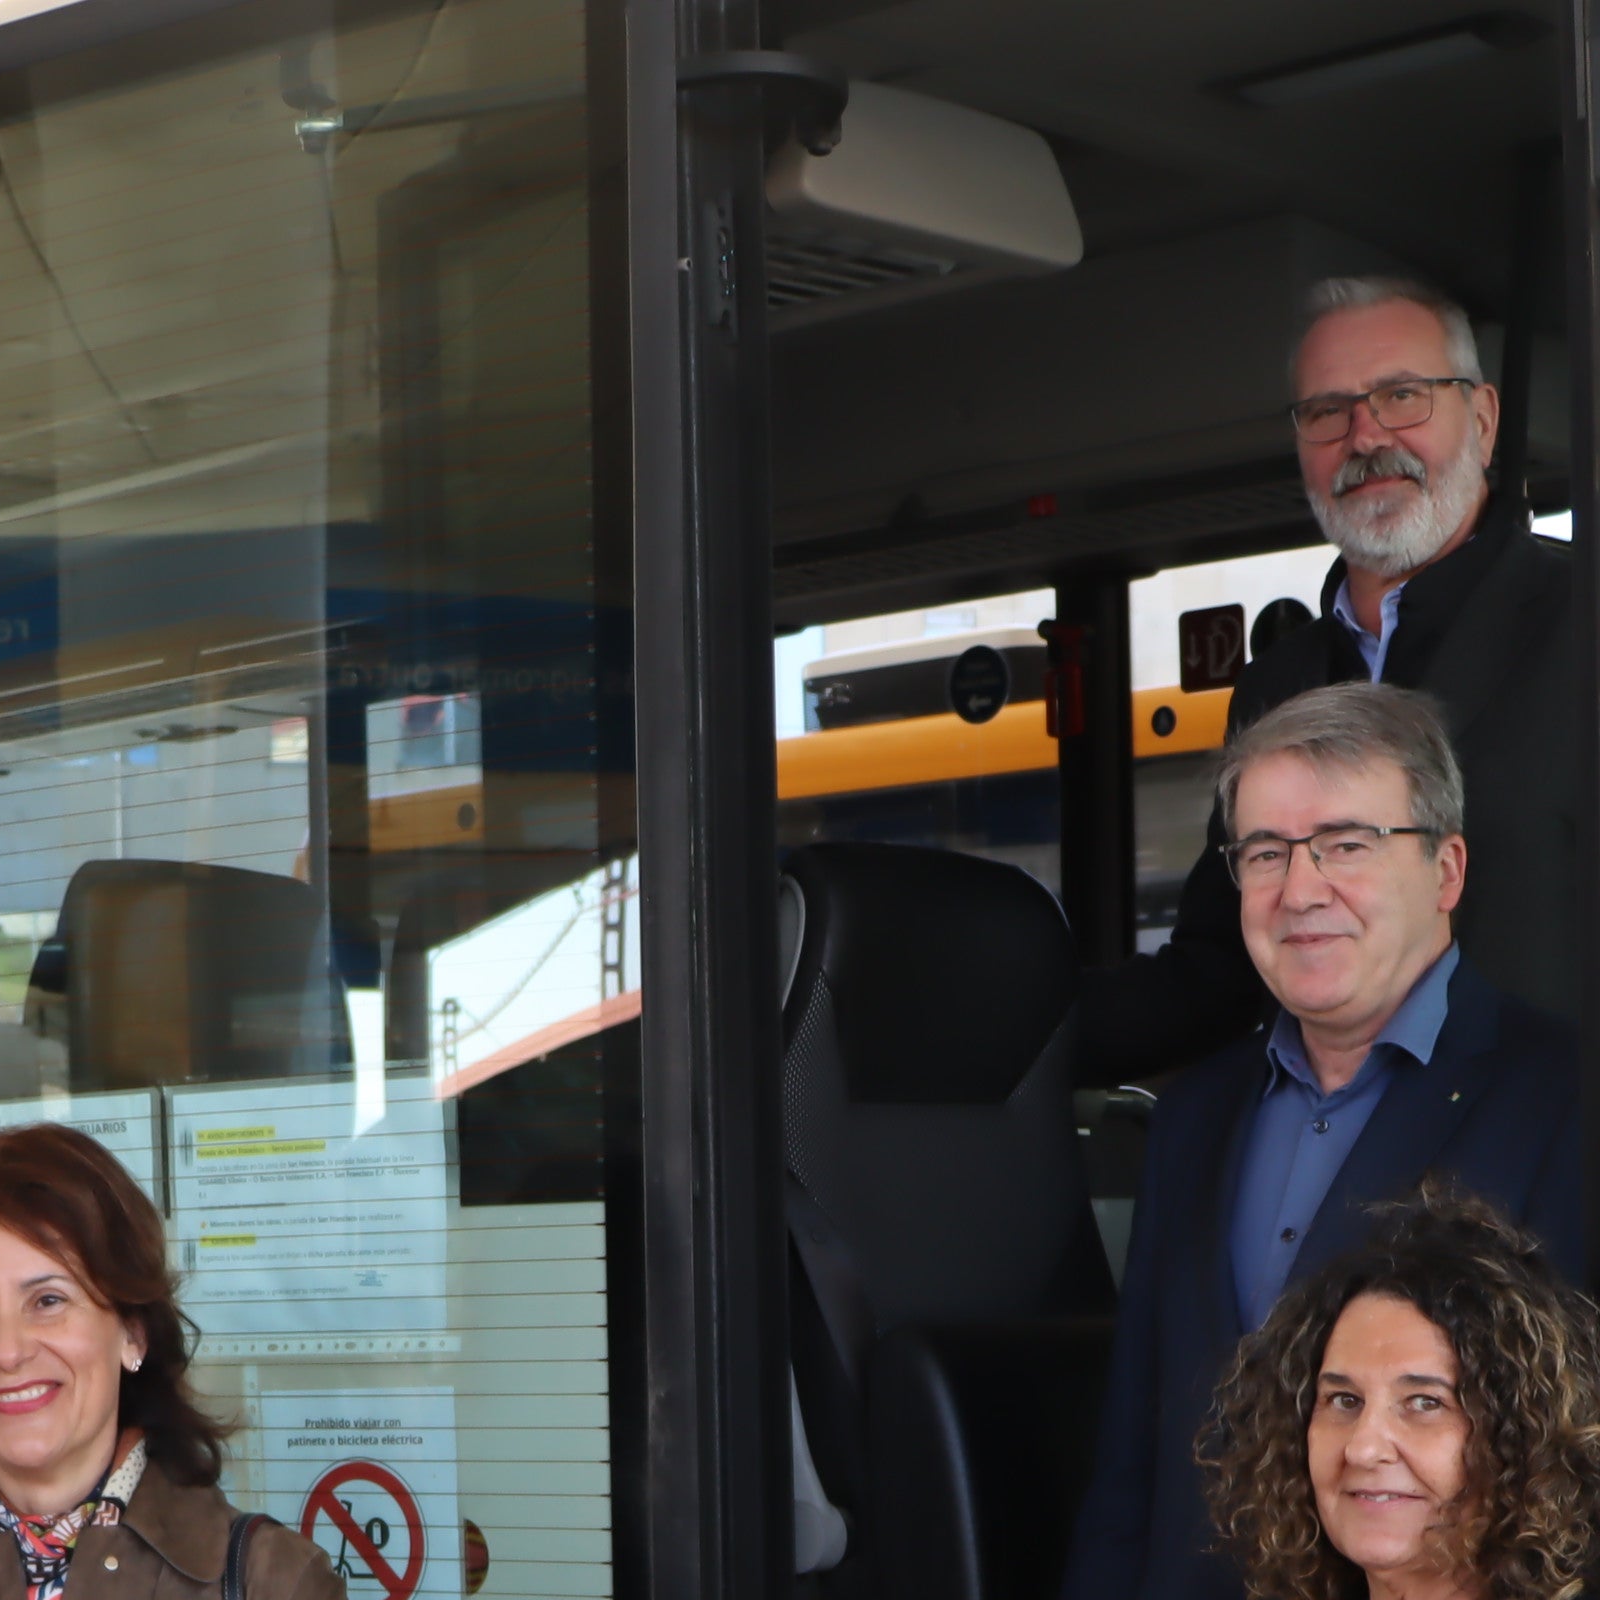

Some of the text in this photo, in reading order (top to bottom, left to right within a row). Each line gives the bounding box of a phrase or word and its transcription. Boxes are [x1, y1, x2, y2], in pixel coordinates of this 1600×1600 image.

[75, 1121, 128, 1136] SUARIOS
[305, 1417, 402, 1430] Prohibido viajar con
[287, 1436, 327, 1448] patinete
[337, 1434, 379, 1446] bicicleta
[381, 1433, 423, 1446] eléctrica
